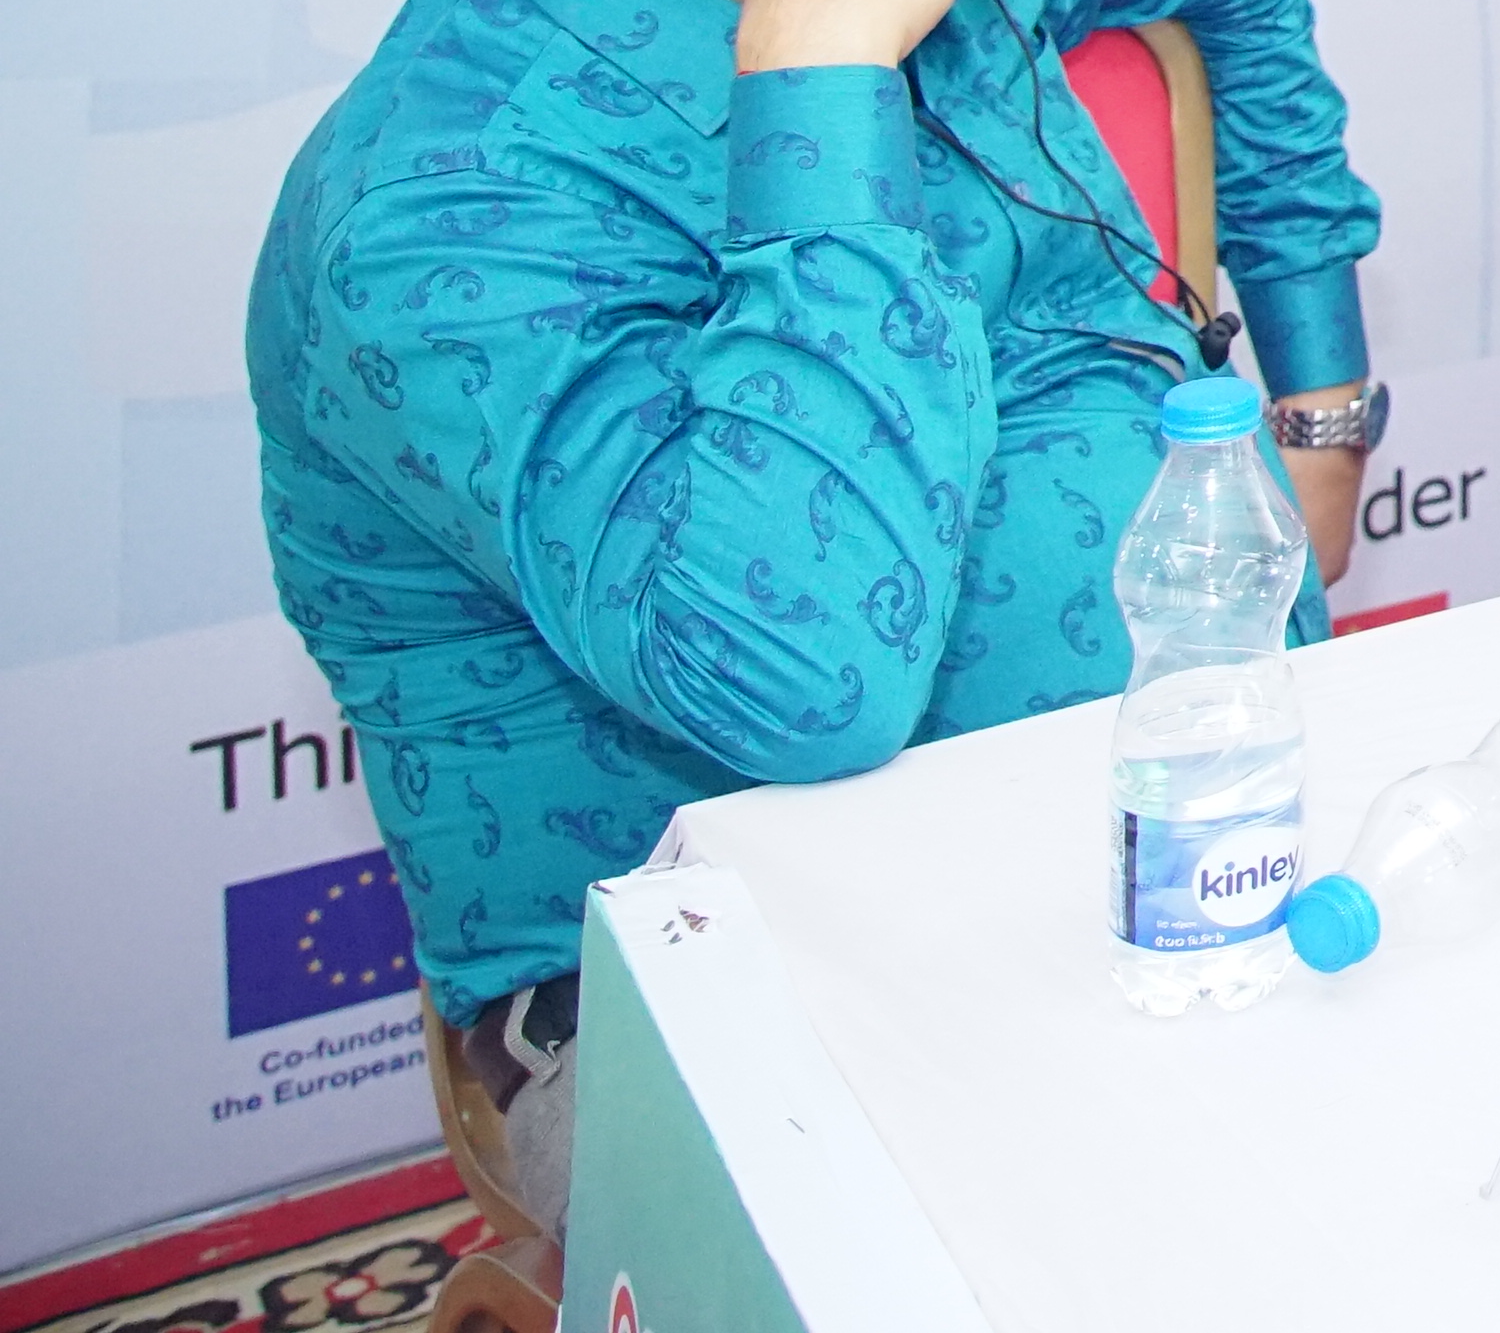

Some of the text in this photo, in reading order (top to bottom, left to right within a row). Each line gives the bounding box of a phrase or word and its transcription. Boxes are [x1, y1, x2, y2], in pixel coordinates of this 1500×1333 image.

[1361, 466, 1487, 543] der
[189, 718, 357, 813] Thi
[1198, 842, 1302, 903] kinley
[259, 1013, 425, 1075] Co-funded
[211, 1048, 425, 1122] the European
